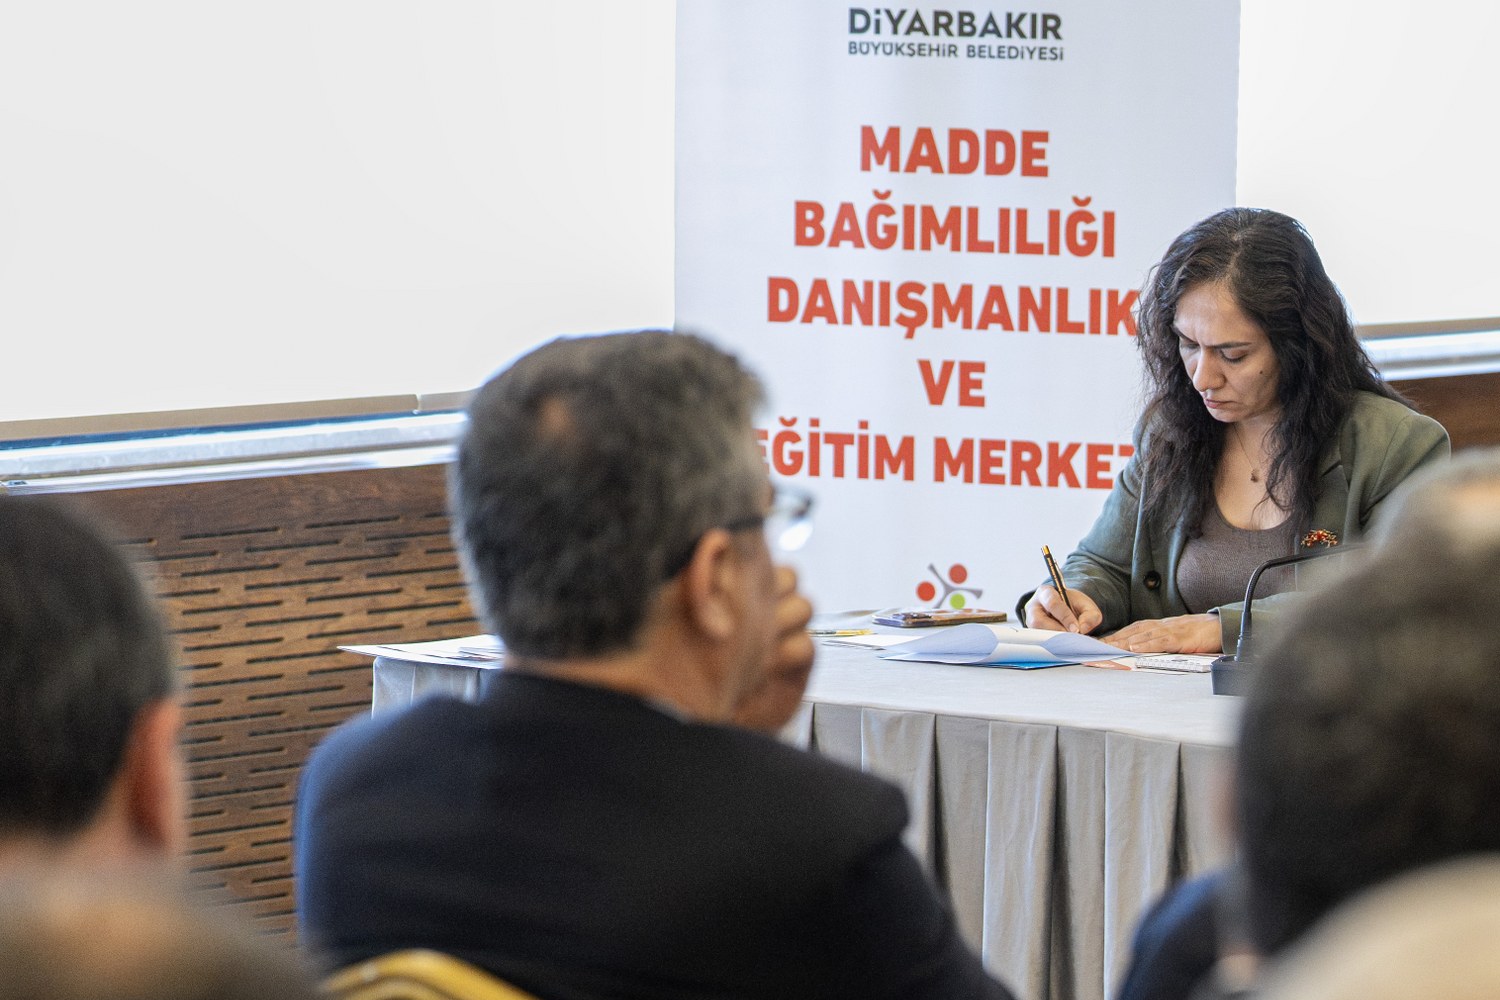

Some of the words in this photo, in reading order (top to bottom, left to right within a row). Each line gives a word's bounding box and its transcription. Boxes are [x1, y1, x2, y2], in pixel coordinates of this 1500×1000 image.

[860, 125, 1049, 178] MADDE
[794, 189, 1116, 258] BAĞIMLILIĞI
[767, 276, 1140, 339] DANIŞMANLIK
[917, 359, 987, 408] VE
